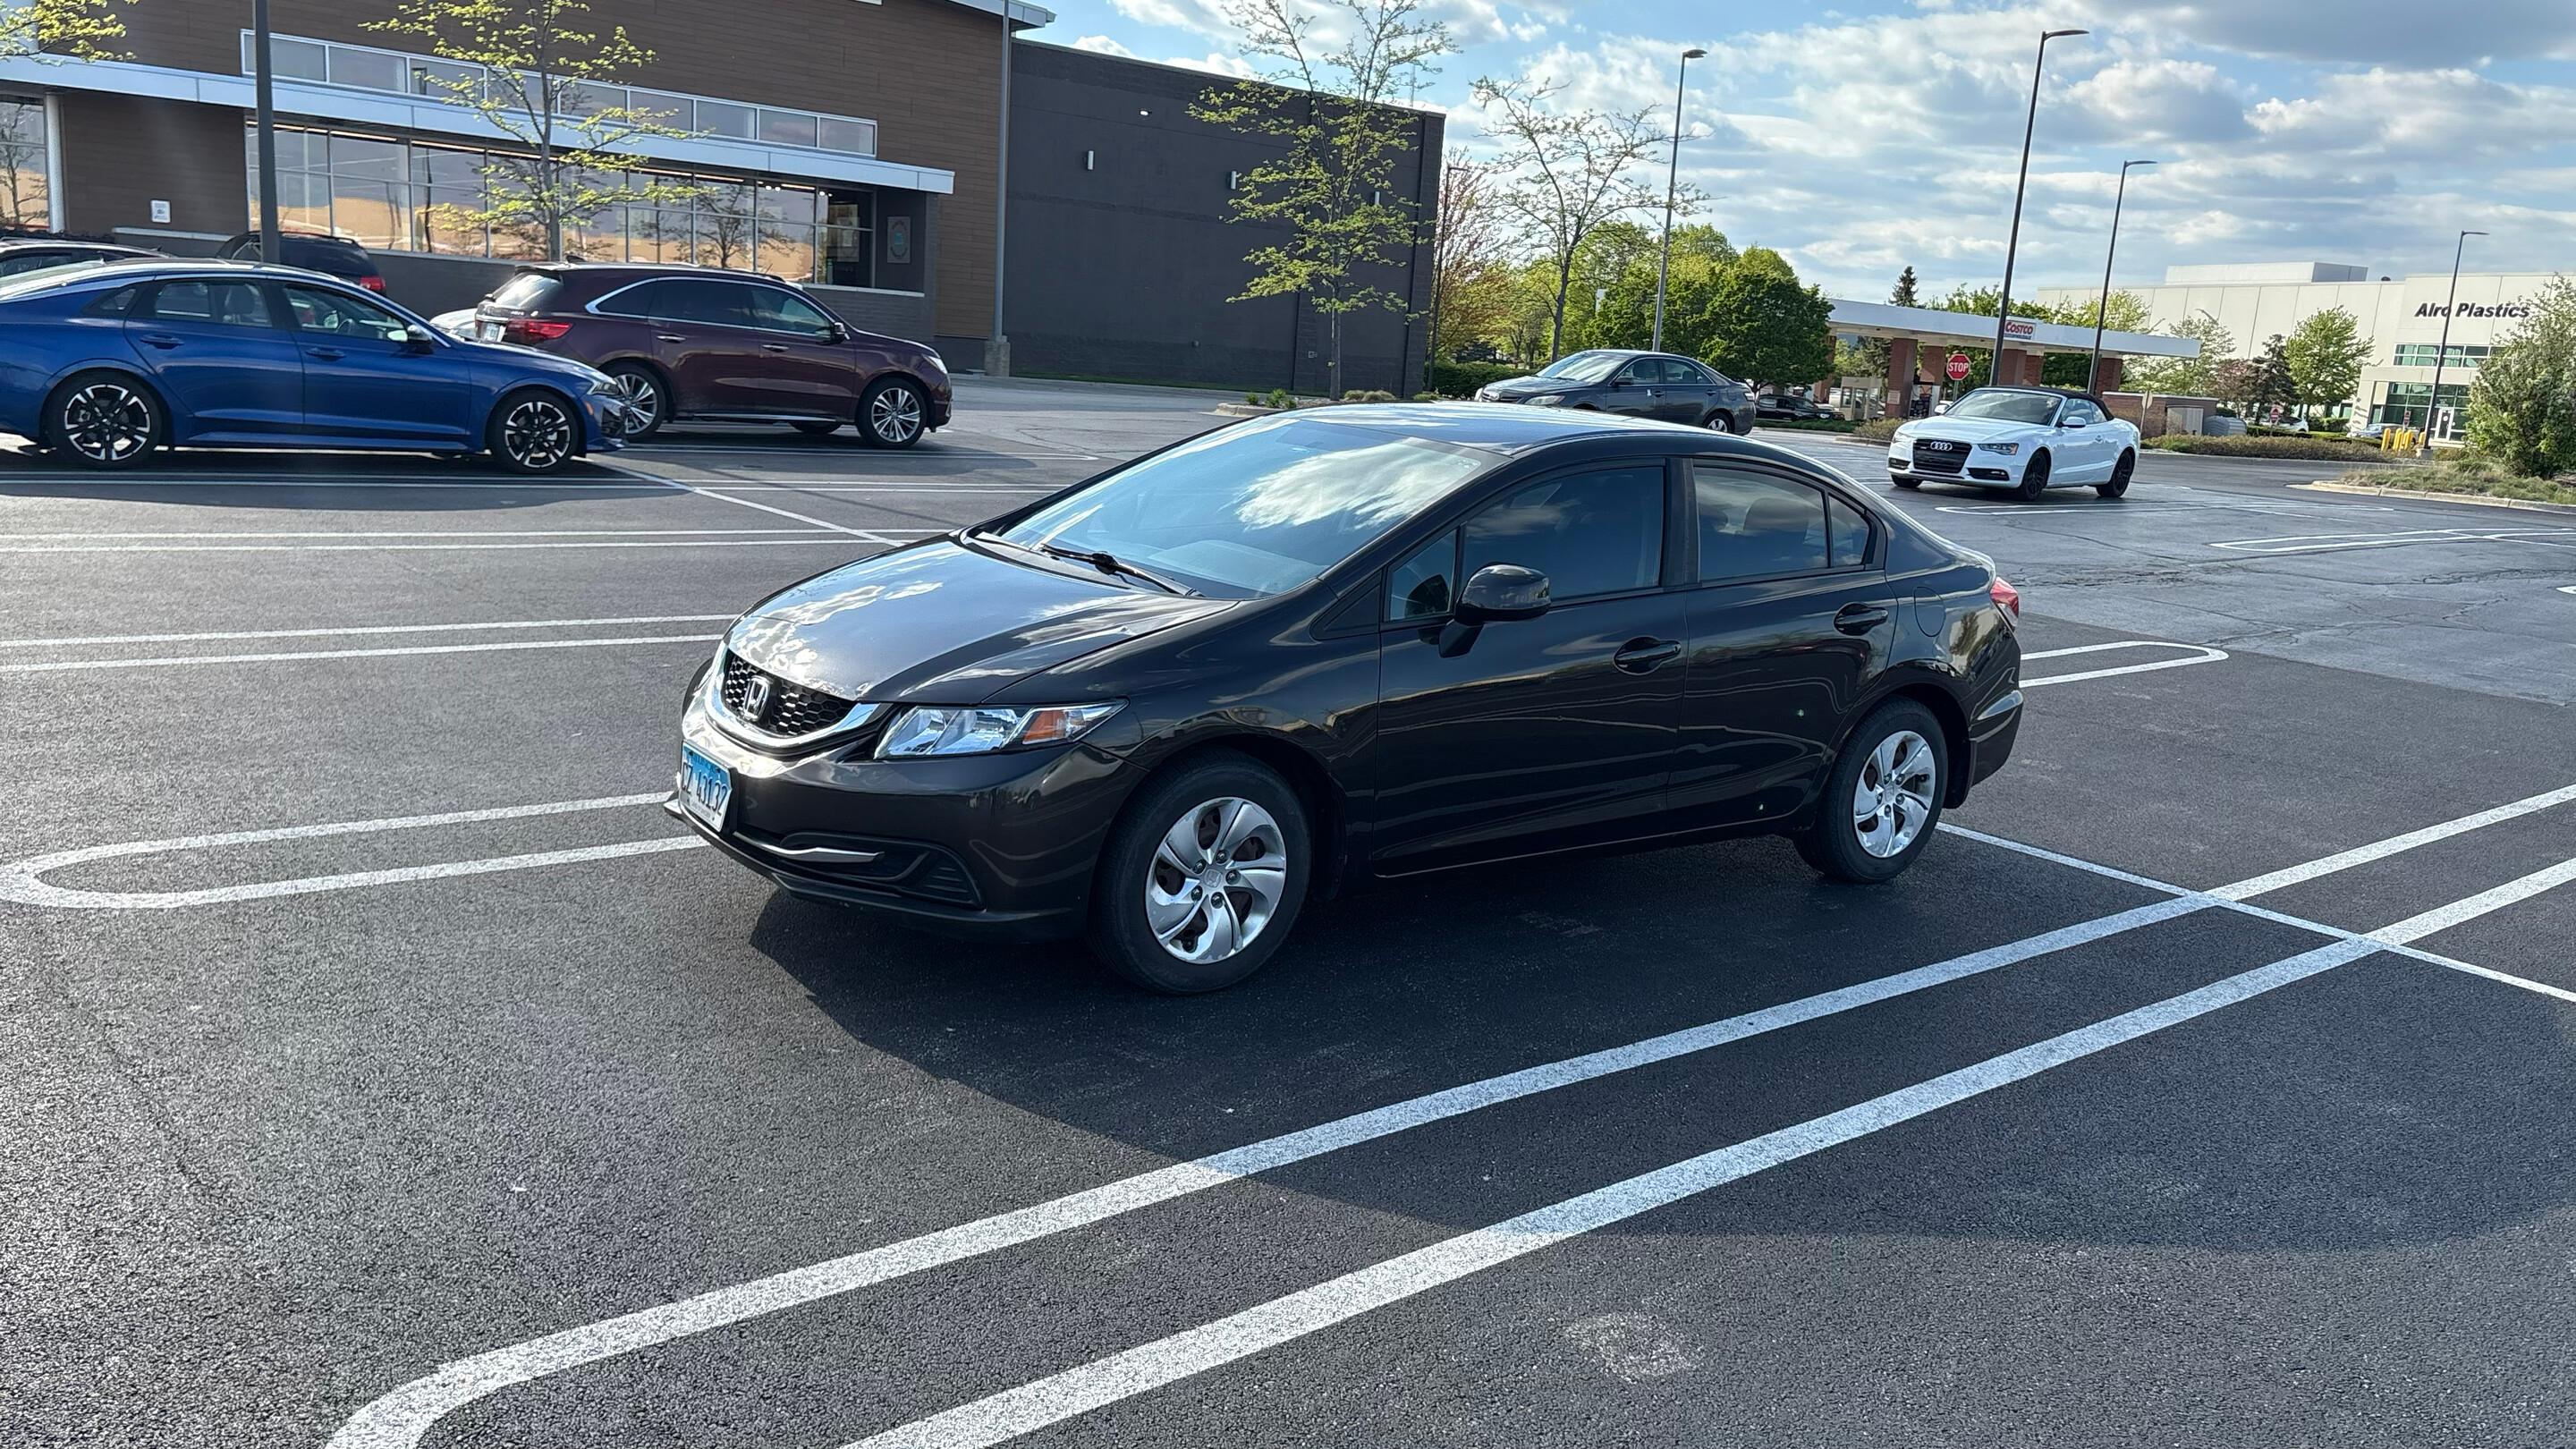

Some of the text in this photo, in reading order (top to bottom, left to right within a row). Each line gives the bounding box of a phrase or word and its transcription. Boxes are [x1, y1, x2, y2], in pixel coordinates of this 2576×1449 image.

[2455, 302, 2530, 318] Plastics
[2005, 321, 2033, 335] COSTCO
[1948, 362, 1969, 372] STOP
